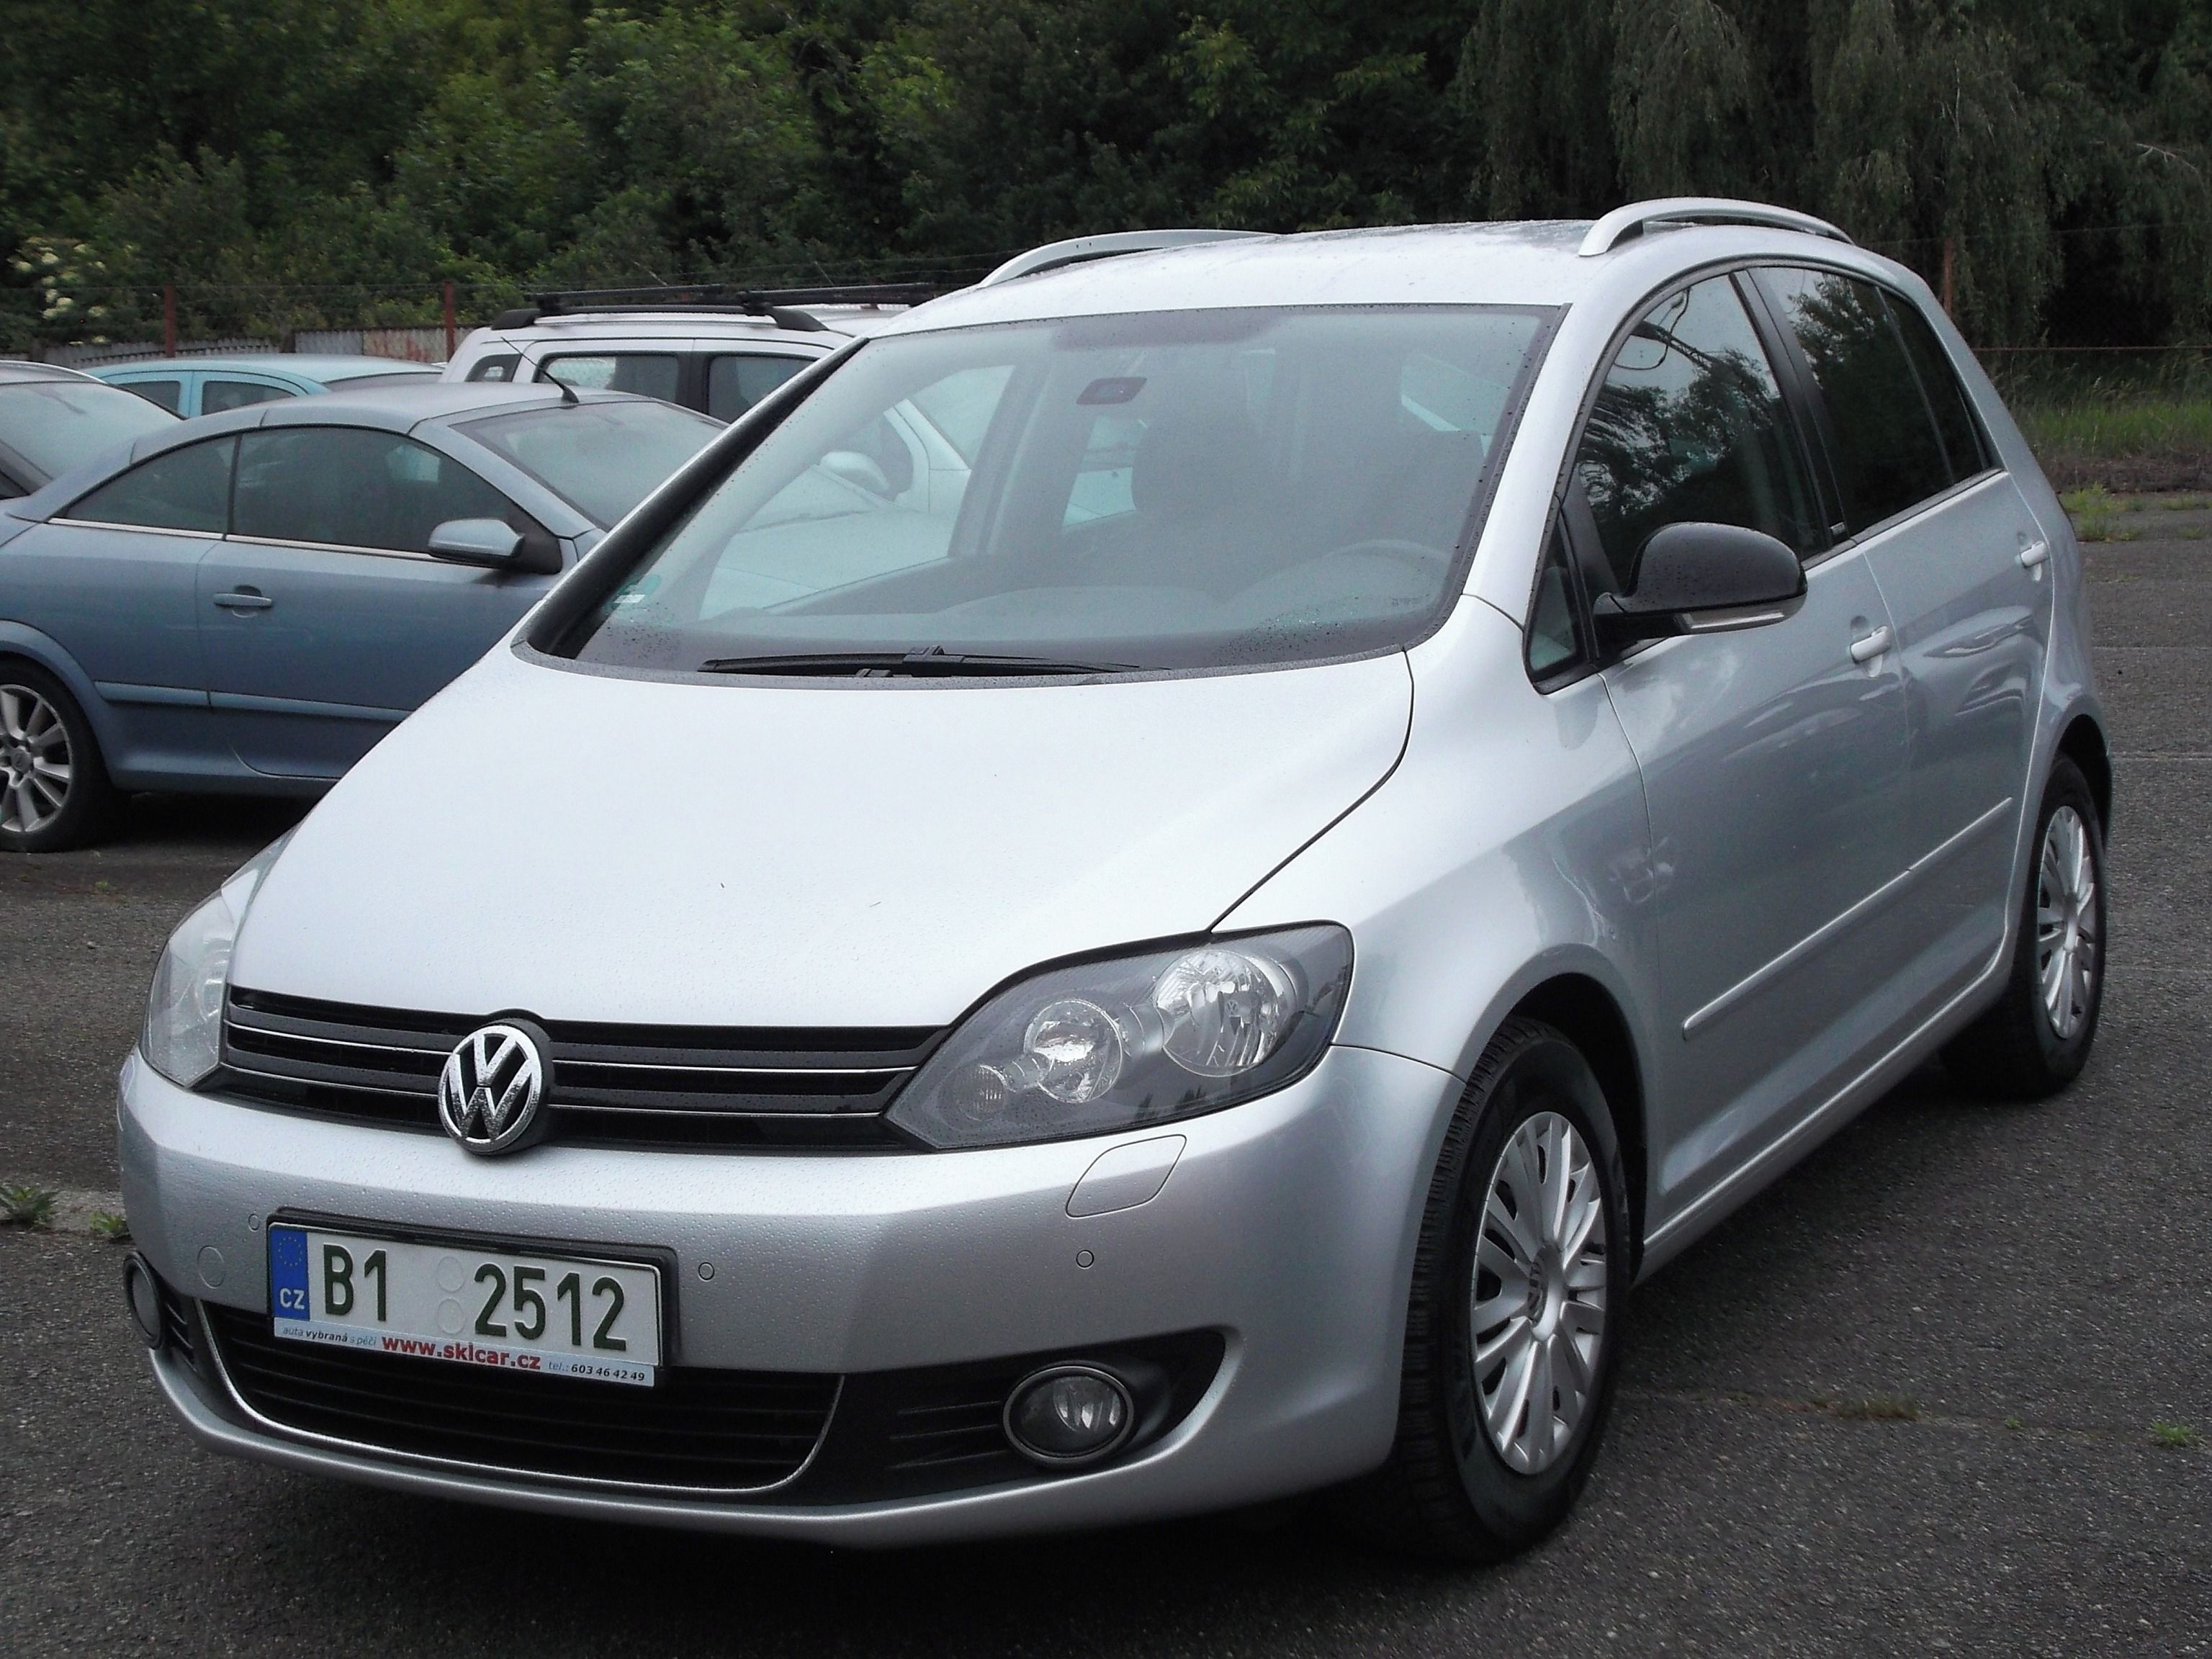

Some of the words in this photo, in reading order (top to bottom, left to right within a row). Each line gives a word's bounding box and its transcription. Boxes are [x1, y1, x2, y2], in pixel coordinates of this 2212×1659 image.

[279, 1287, 305, 1310] CZ
[323, 1243, 387, 1321] B1
[474, 1263, 626, 1351] 2512
[282, 1326, 304, 1336] auta
[305, 1329, 348, 1342] vybraná
[571, 1364, 593, 1375] 603
[595, 1367, 610, 1377] 46
[613, 1370, 627, 1379] 42
[630, 1372, 645, 1381] 49
